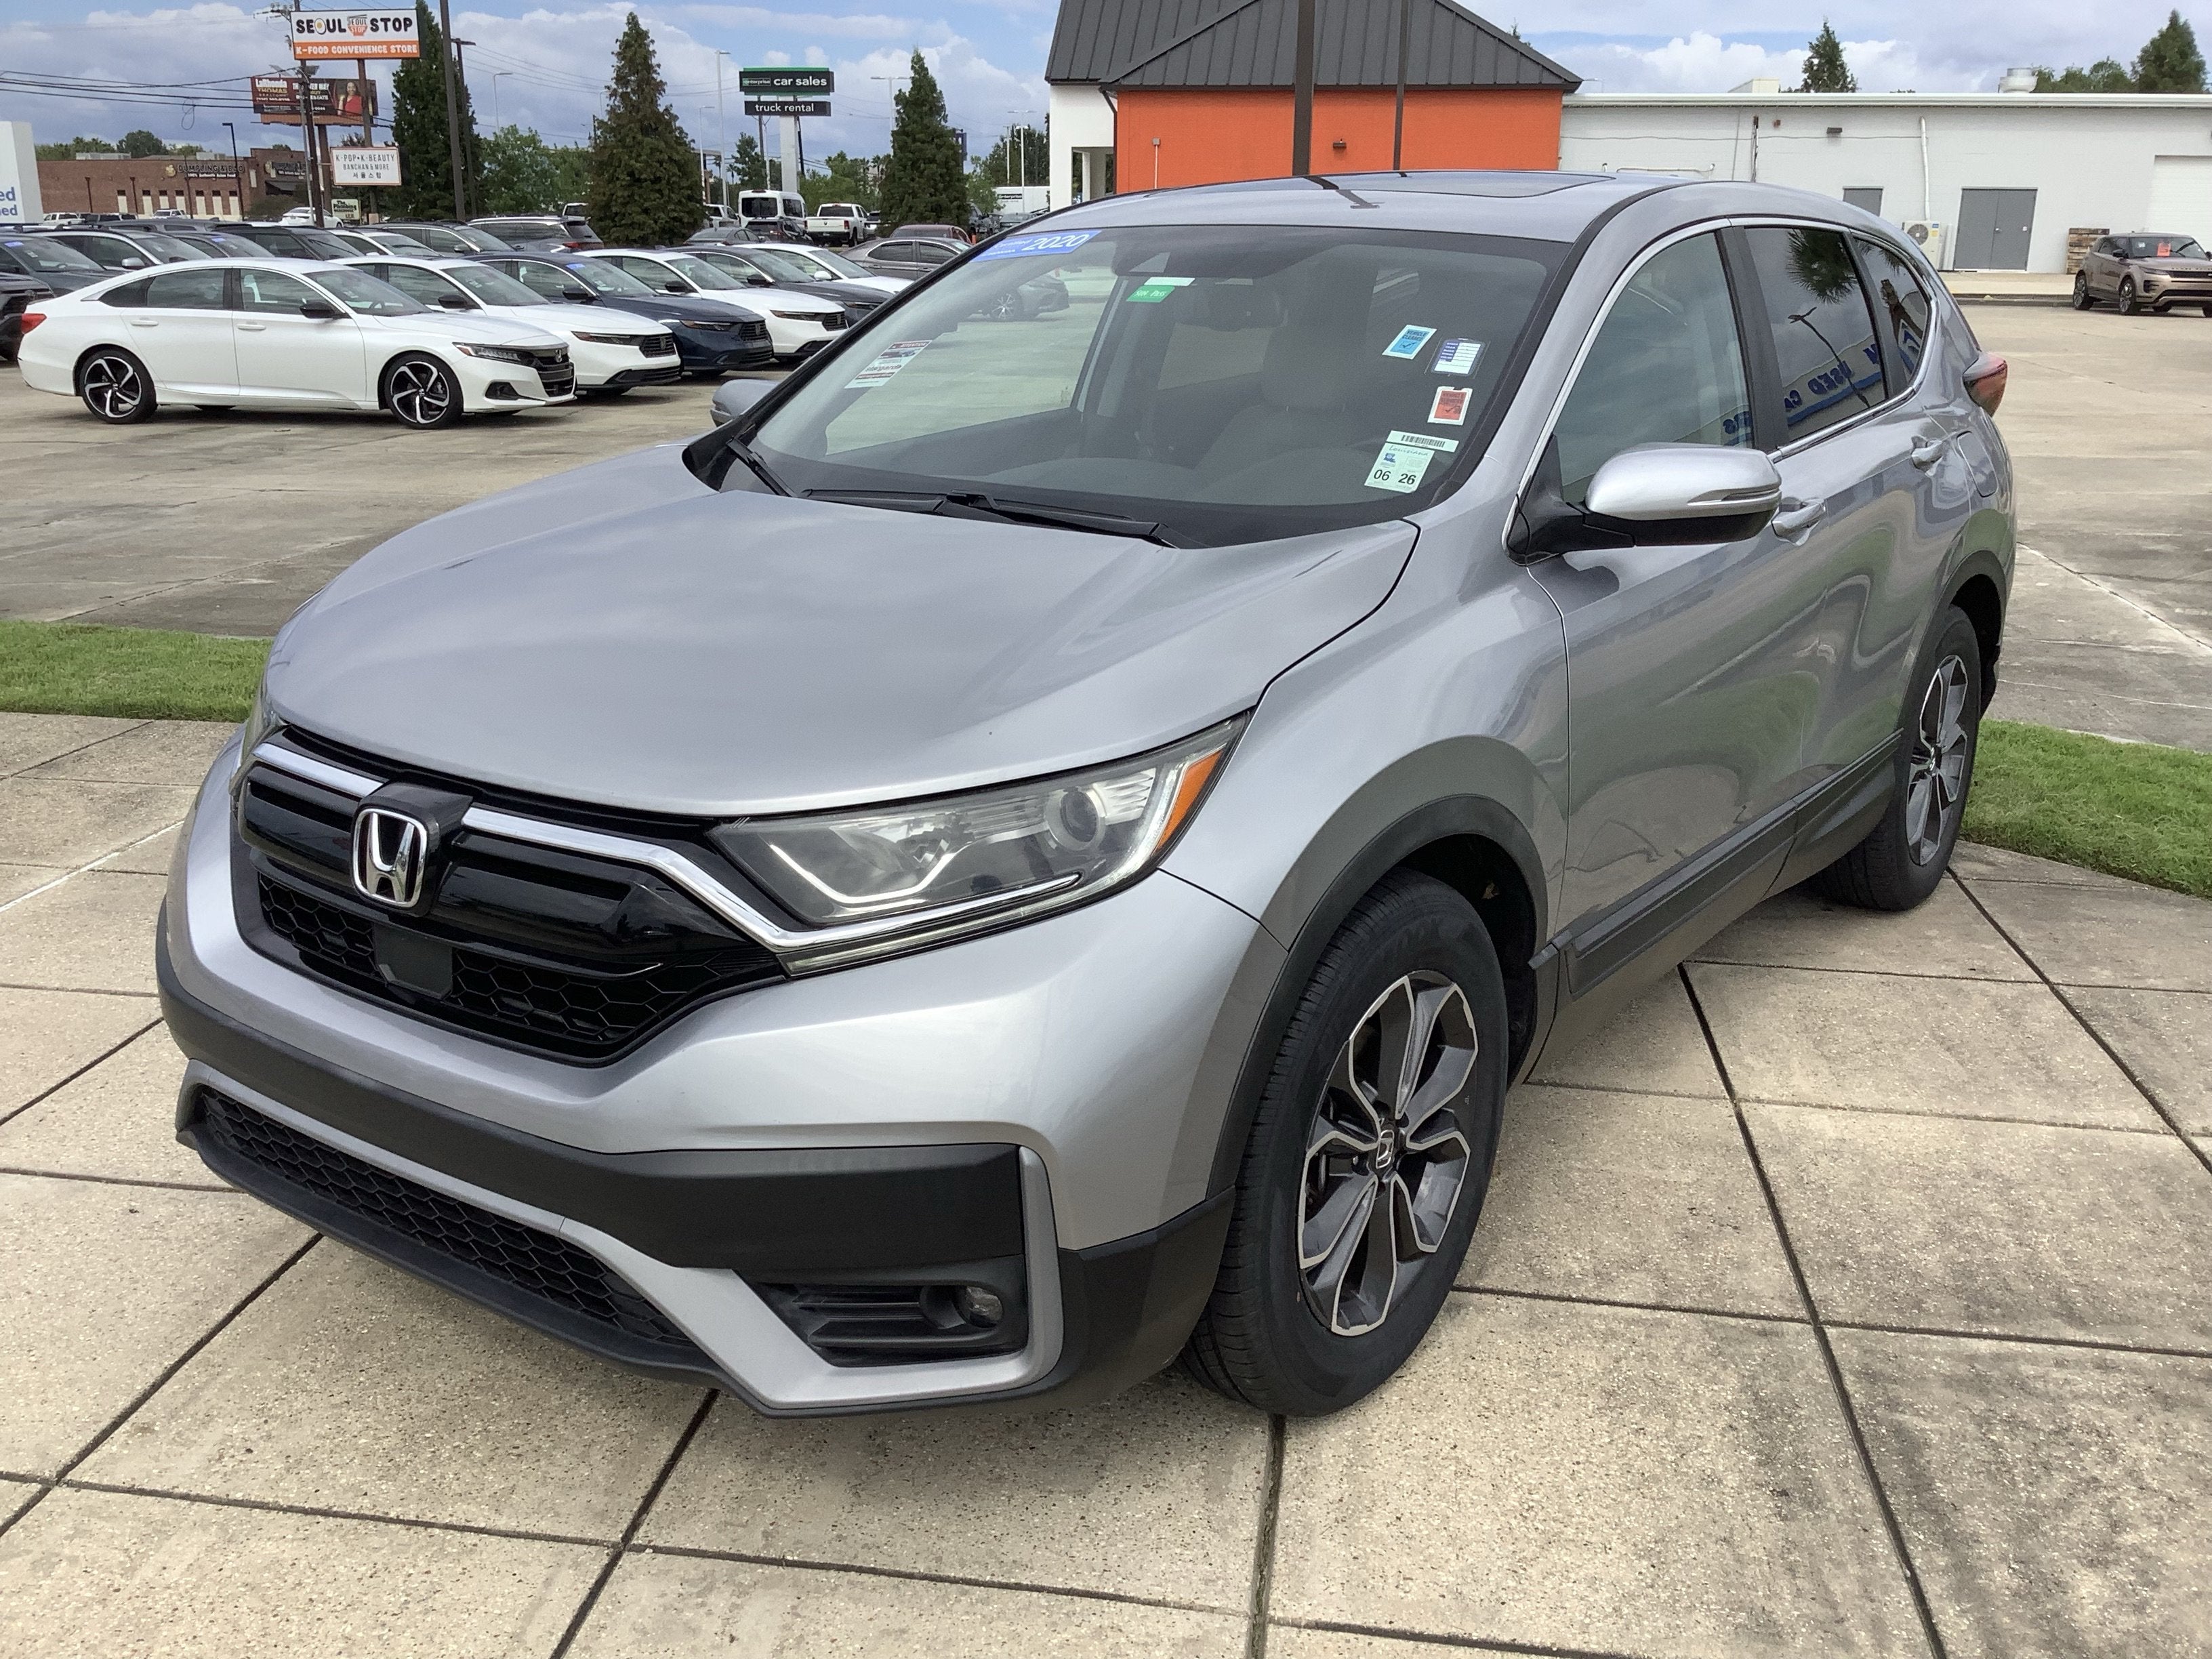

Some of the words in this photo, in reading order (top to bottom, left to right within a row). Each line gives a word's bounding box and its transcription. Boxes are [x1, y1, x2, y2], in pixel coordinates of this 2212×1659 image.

[370, 18, 413, 33] STOP
[295, 46, 329, 55] K-FOOD
[331, 45, 388, 54] CONVENIENCE
[390, 44, 417, 54] STORE
[796, 76, 827, 86] sales
[755, 103, 781, 112] truck
[785, 103, 814, 112] rental
[1022, 234, 1090, 251] 2020
[1389, 445, 1429, 456] Louisiana
[1374, 469, 1391, 481] 06
[1398, 473, 1416, 485] 26
